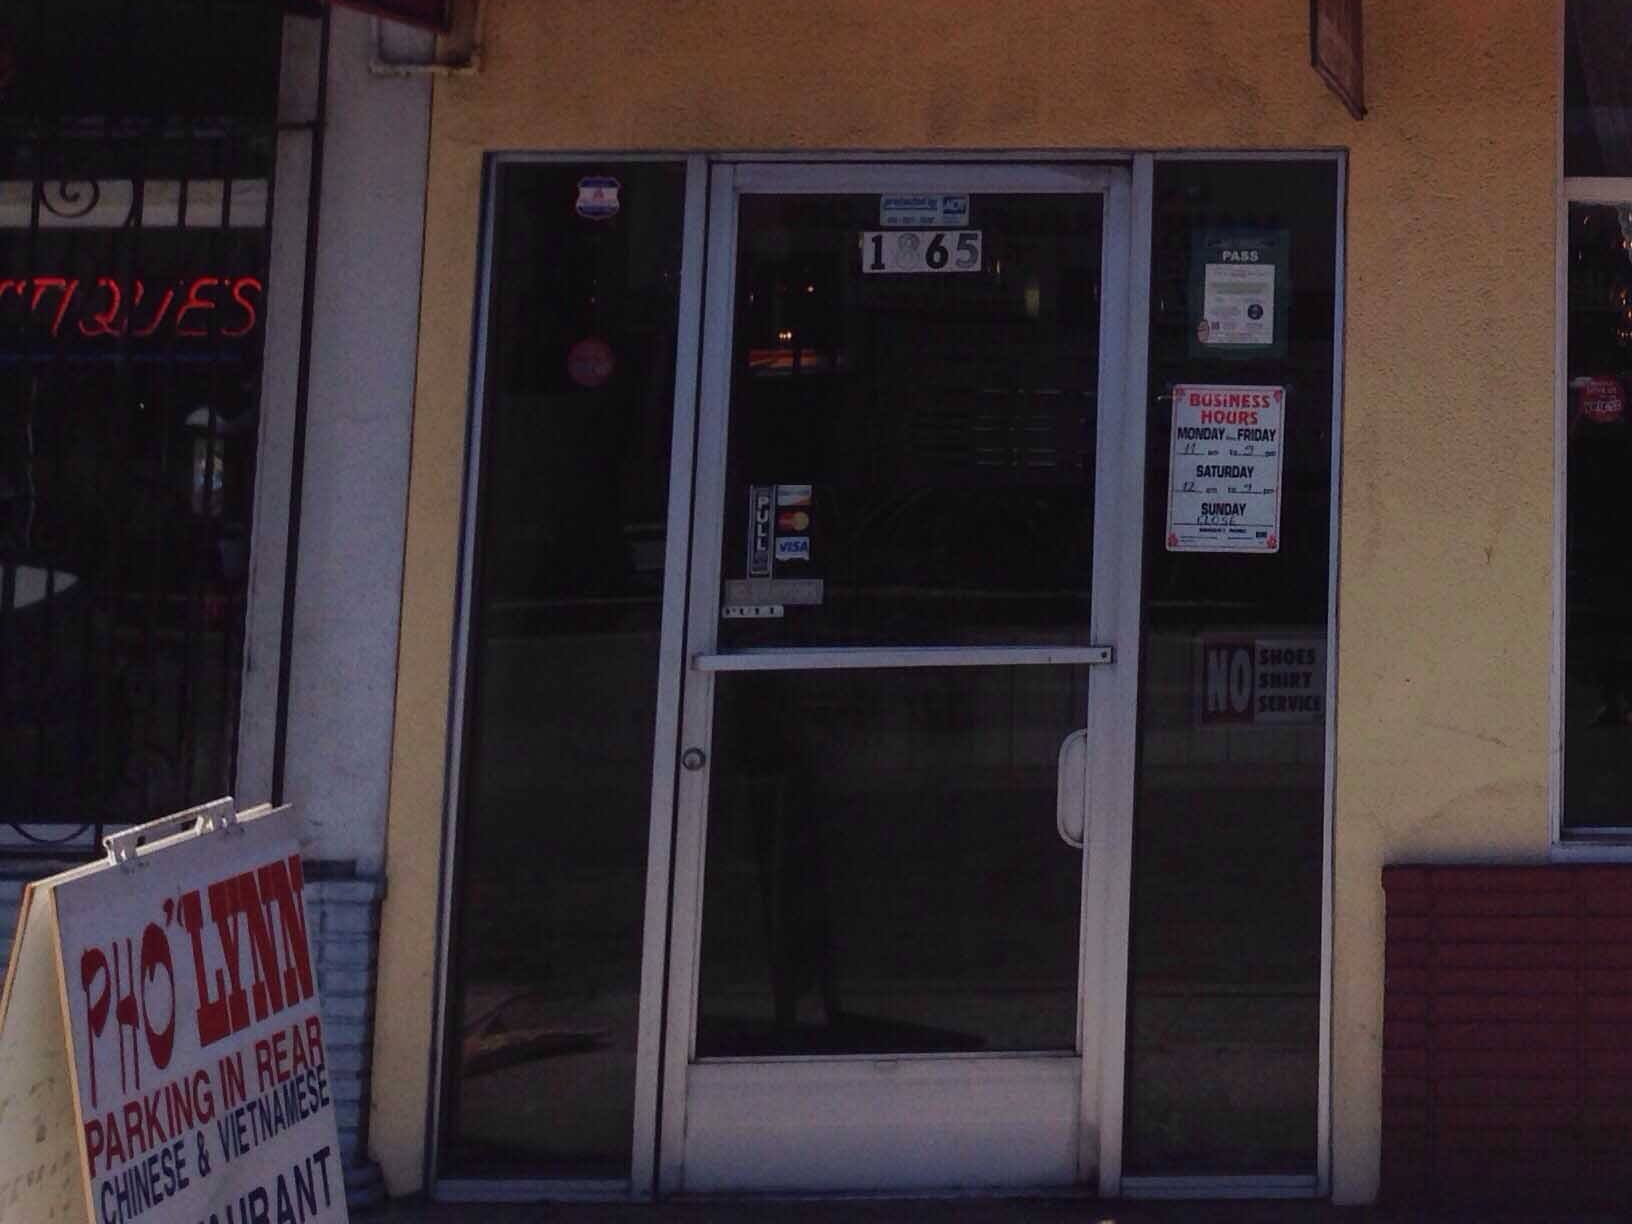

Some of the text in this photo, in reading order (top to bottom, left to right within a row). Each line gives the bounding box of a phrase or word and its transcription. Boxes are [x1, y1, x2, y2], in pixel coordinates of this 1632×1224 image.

[1222, 250, 1259, 263] PASS
[0, 274, 262, 337] TIQUES
[1200, 410, 1259, 425] HOURS
[1177, 427, 1226, 441] MONDAY
[1237, 428, 1277, 442] FRIDAY
[1196, 465, 1254, 478] SATURDAY
[1201, 502, 1247, 516] SUNDAY
[780, 541, 808, 553] VISA
[1207, 648, 1316, 713] NO SHOES
[1258, 672, 1313, 689] SHIRT
[1258, 695, 1322, 713] SERVICE
[177, 853, 314, 1048] LYNN
[84, 1016, 325, 1179] PARKING IN REAR
[100, 1063, 330, 1224] CHINESE & VIETNAMESE
